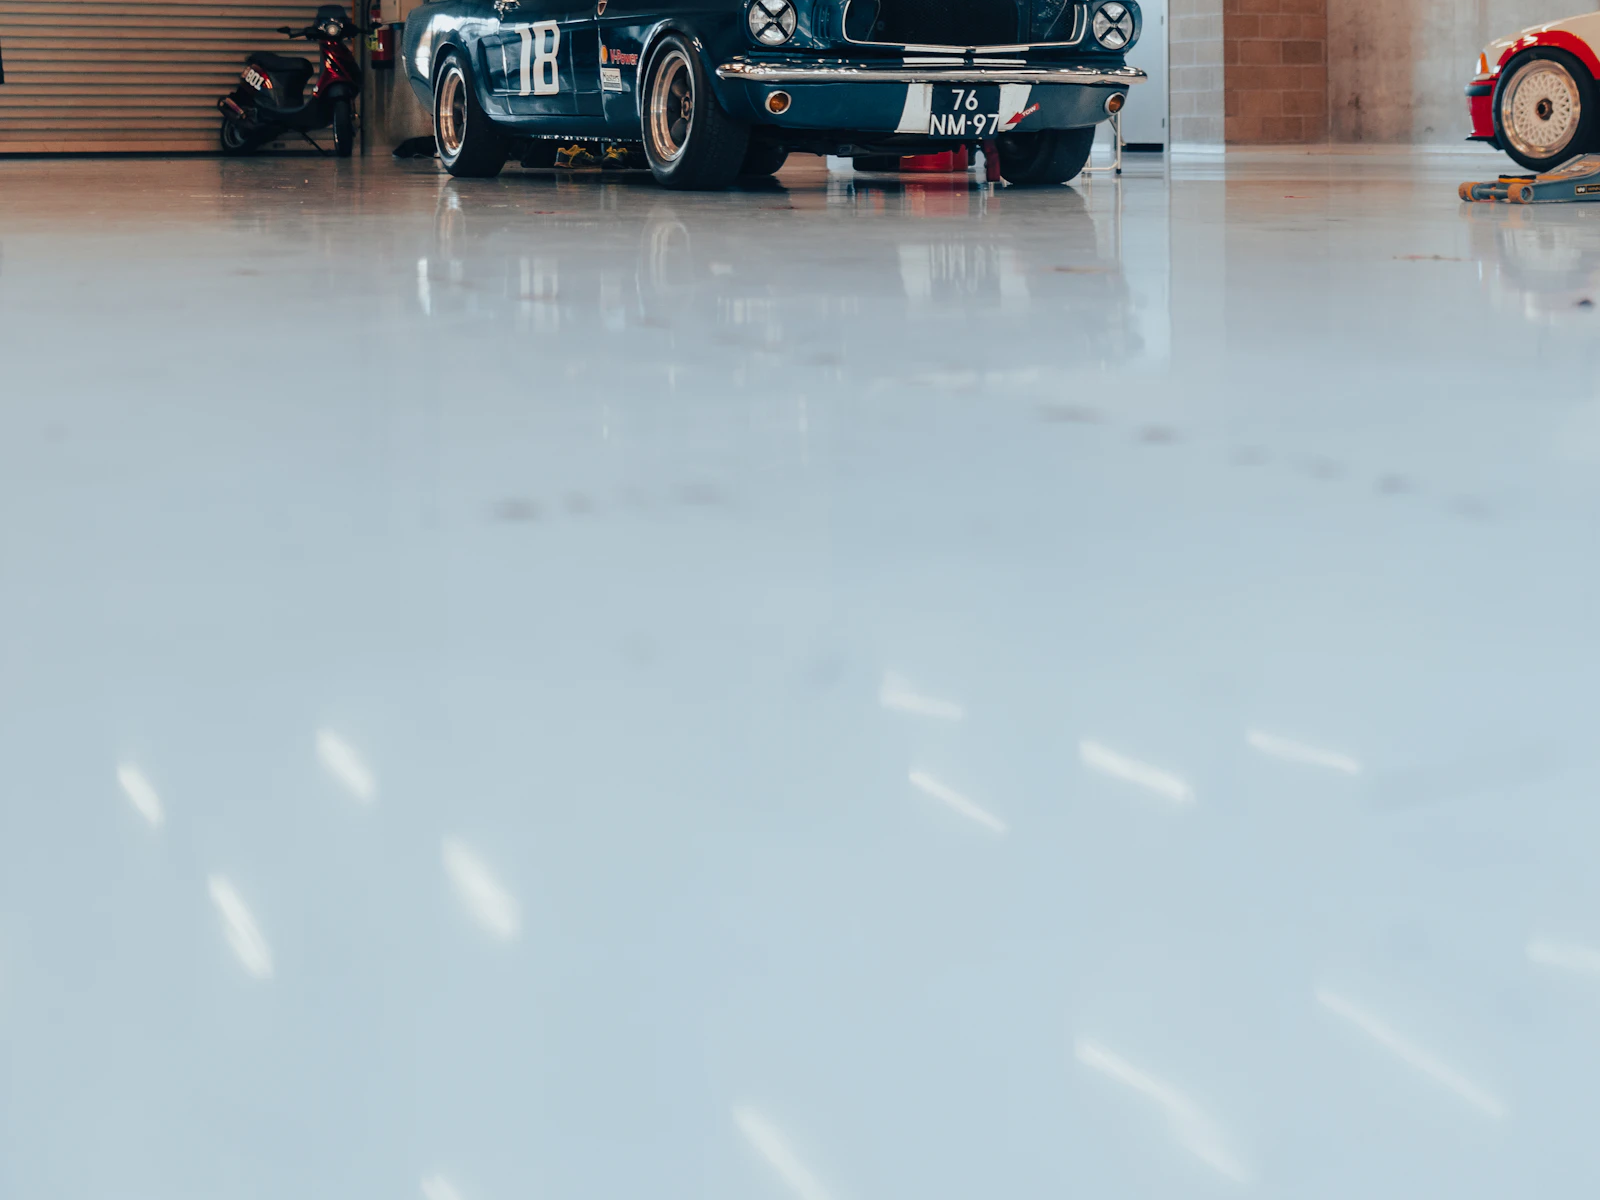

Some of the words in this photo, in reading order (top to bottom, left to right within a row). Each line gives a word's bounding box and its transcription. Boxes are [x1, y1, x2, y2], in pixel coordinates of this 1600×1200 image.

[515, 20, 560, 96] 18
[610, 49, 638, 65] V-Power
[245, 69, 264, 90] 801
[952, 89, 978, 111] 76
[1022, 105, 1036, 117] TOW
[930, 114, 999, 135] NM-97
